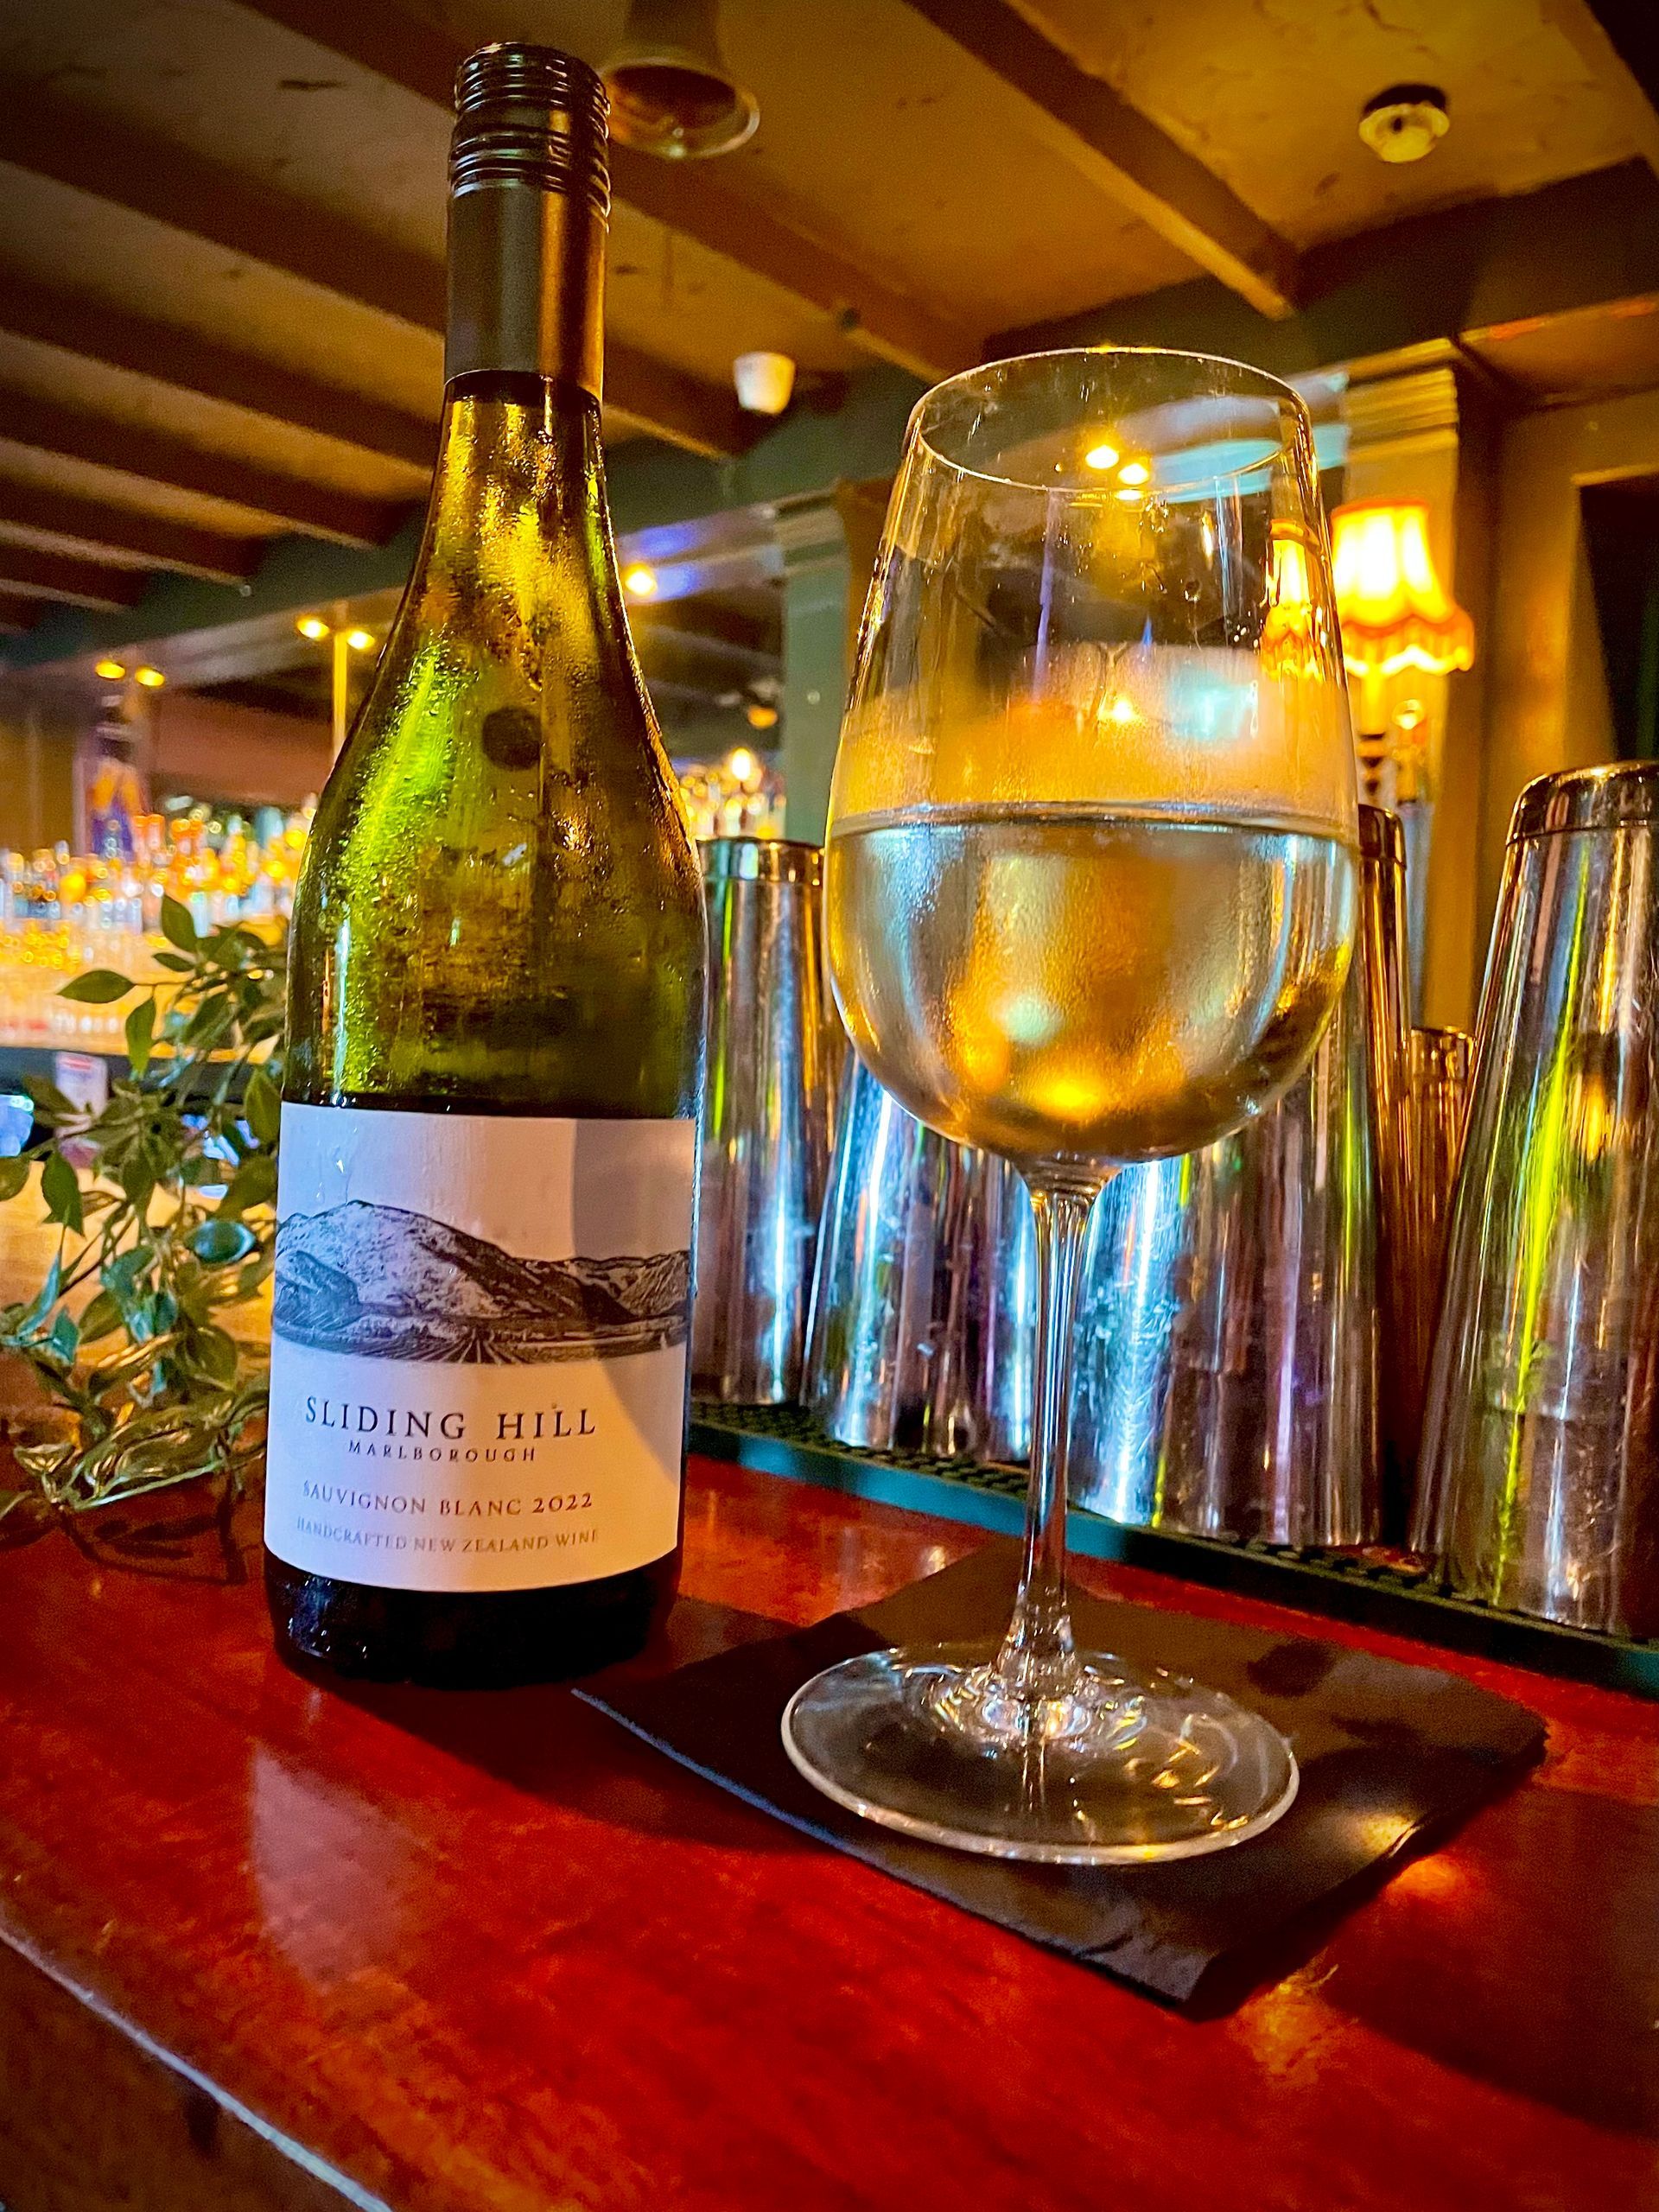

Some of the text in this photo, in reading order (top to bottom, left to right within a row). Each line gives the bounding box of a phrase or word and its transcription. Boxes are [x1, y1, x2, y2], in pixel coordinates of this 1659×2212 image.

[305, 1396, 596, 1440] SLIDING HILL
[347, 1440, 536, 1463] MARLBOROUGH
[303, 1480, 593, 1516] SAUVIGNON BLANC 2022
[296, 1516, 598, 1553] HANDCRAFTED NEW ZEALAND WINE
